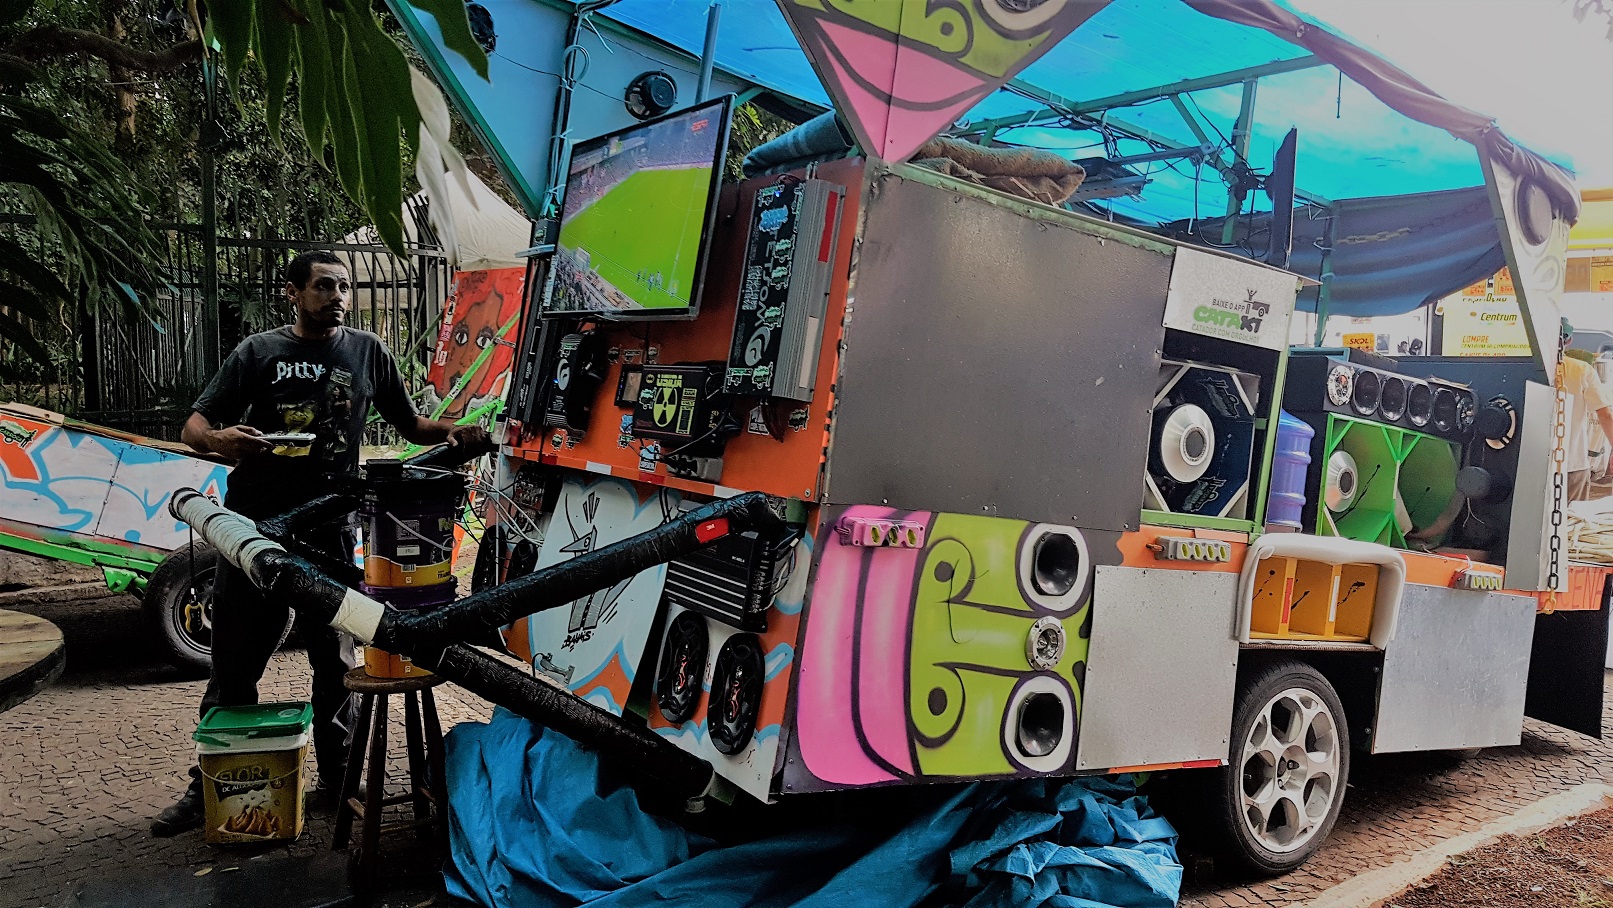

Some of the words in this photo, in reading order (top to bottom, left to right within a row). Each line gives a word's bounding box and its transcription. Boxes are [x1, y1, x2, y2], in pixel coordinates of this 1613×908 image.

[1212, 298, 1228, 309] BAIXE
[1234, 305, 1245, 314] APP
[1480, 312, 1517, 322] Centrum
[1191, 323, 1217, 335] CATADOR
[1218, 328, 1230, 338] COM
[1349, 337, 1369, 345] SKOL
[1462, 335, 1490, 343] COMPRE
